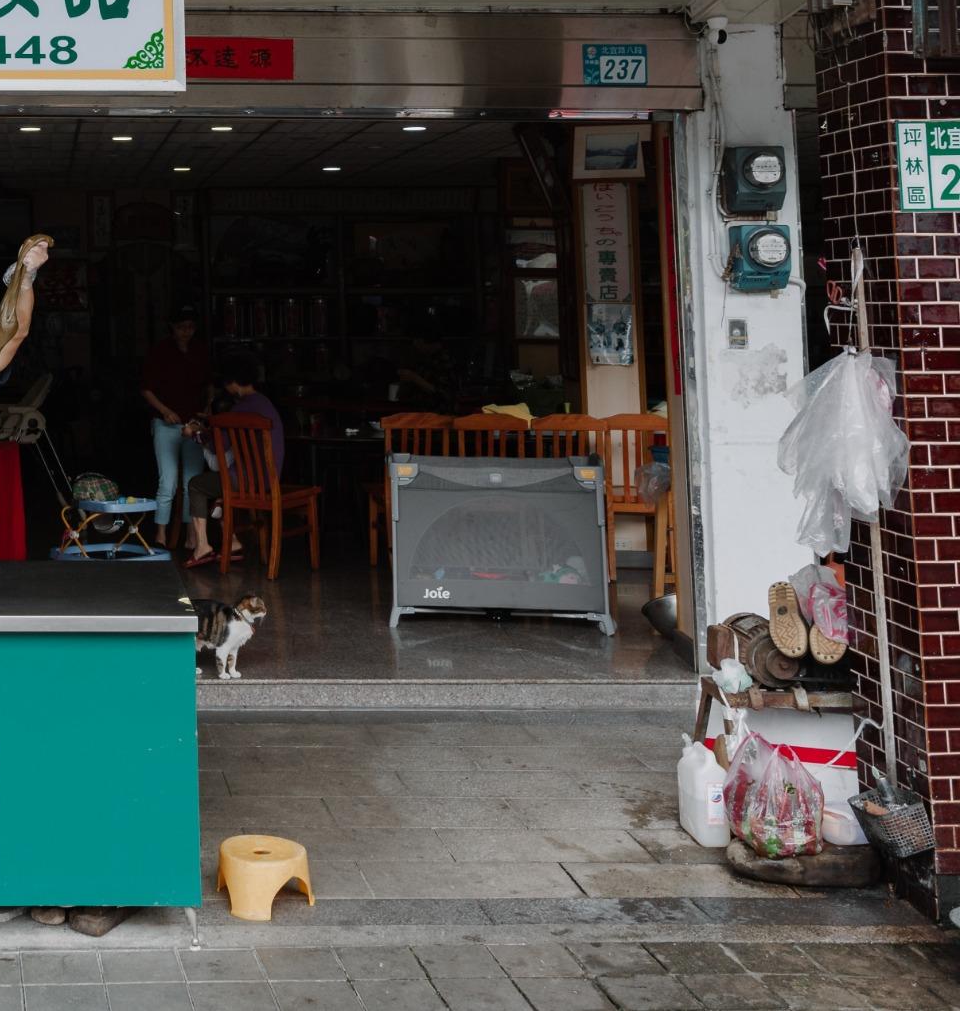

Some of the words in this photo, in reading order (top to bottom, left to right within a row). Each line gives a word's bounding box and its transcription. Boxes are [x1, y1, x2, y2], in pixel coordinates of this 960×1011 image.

[603, 58, 643, 80] 237
[904, 128, 926, 204] 坪林區
[423, 586, 451, 599] Joie
